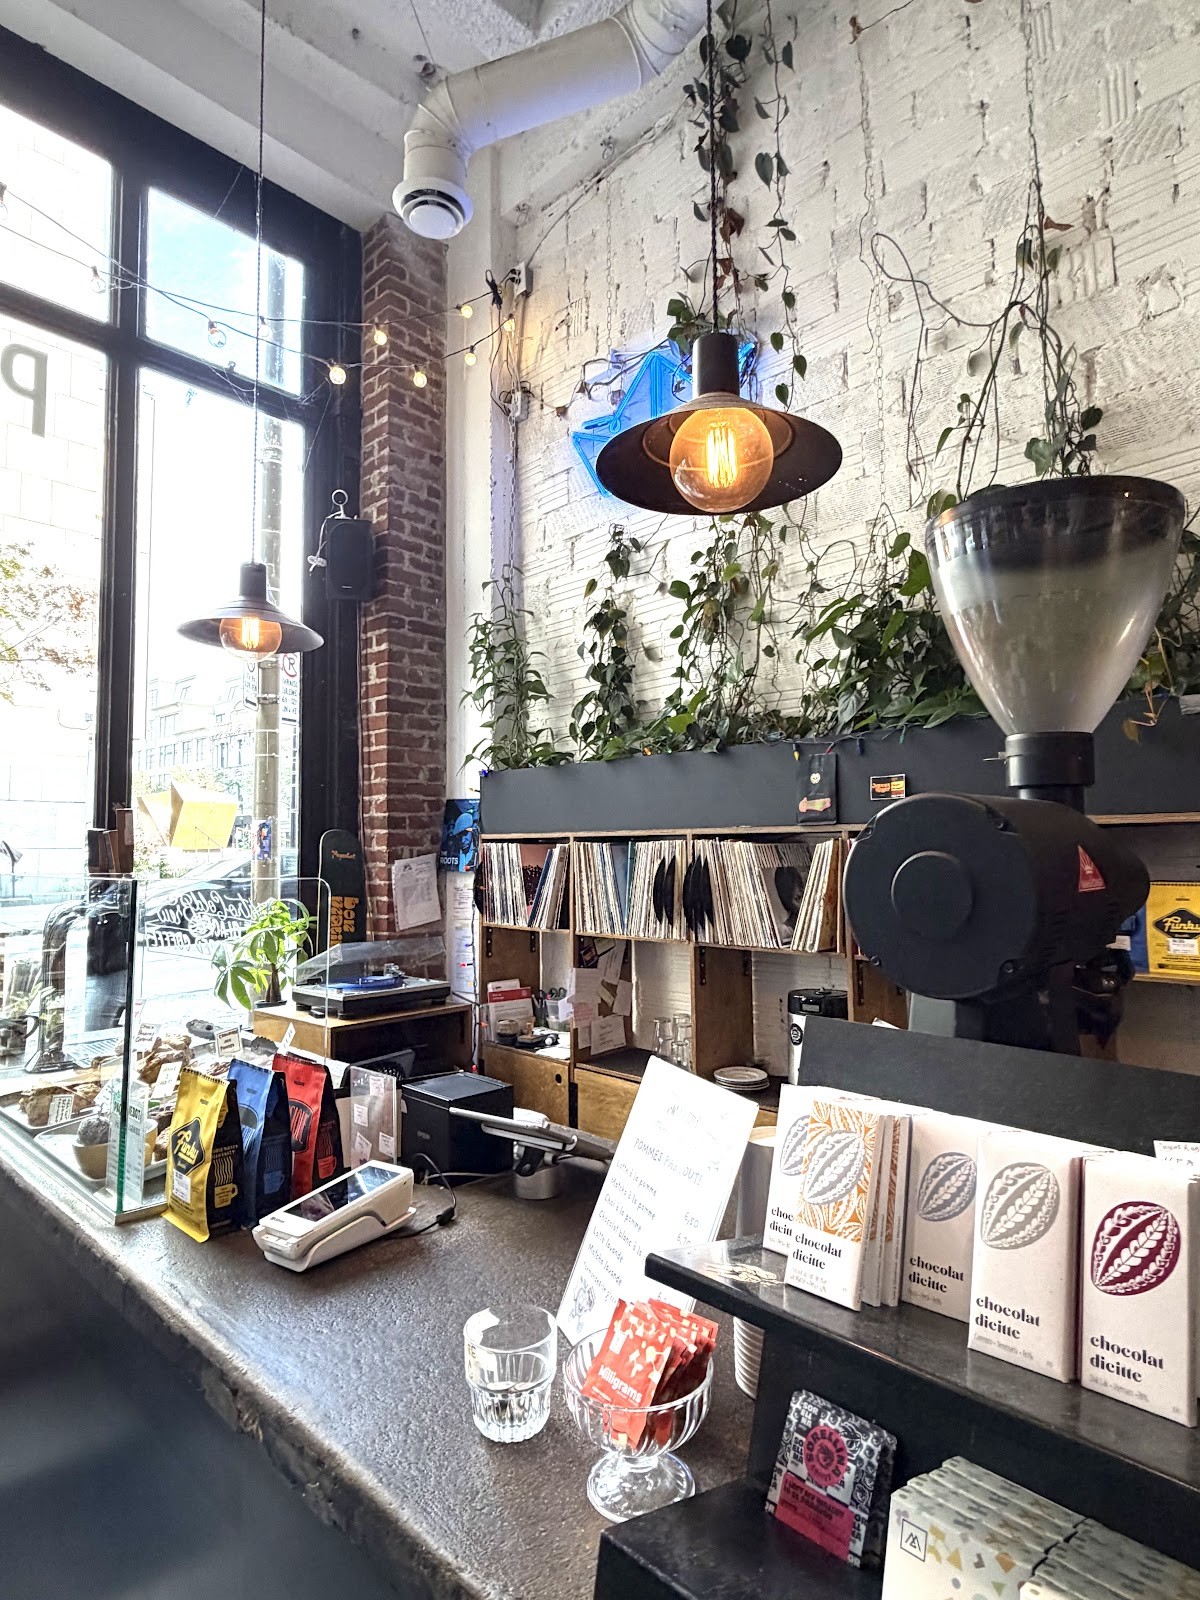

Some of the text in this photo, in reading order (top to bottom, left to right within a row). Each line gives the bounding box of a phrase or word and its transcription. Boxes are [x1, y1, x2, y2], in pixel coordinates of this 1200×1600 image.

[440, 857, 459, 865] ROOTS
[173, 1129, 199, 1165] Funky
[634, 1137, 664, 1162] POMMES
[638, 1179, 657, 1197] pomme
[623, 1214, 642, 1233] pomme
[636, 1202, 656, 1221] pomme
[771, 1206, 794, 1221] choc
[794, 1232, 842, 1259] chocolat
[909, 1255, 965, 1283] chocolat
[975, 1295, 1041, 1328] chocolat
[1089, 1334, 1165, 1370] chocolat
[597, 1363, 643, 1404] Milligrams
[806, 1428, 846, 1478] SORELLINA
